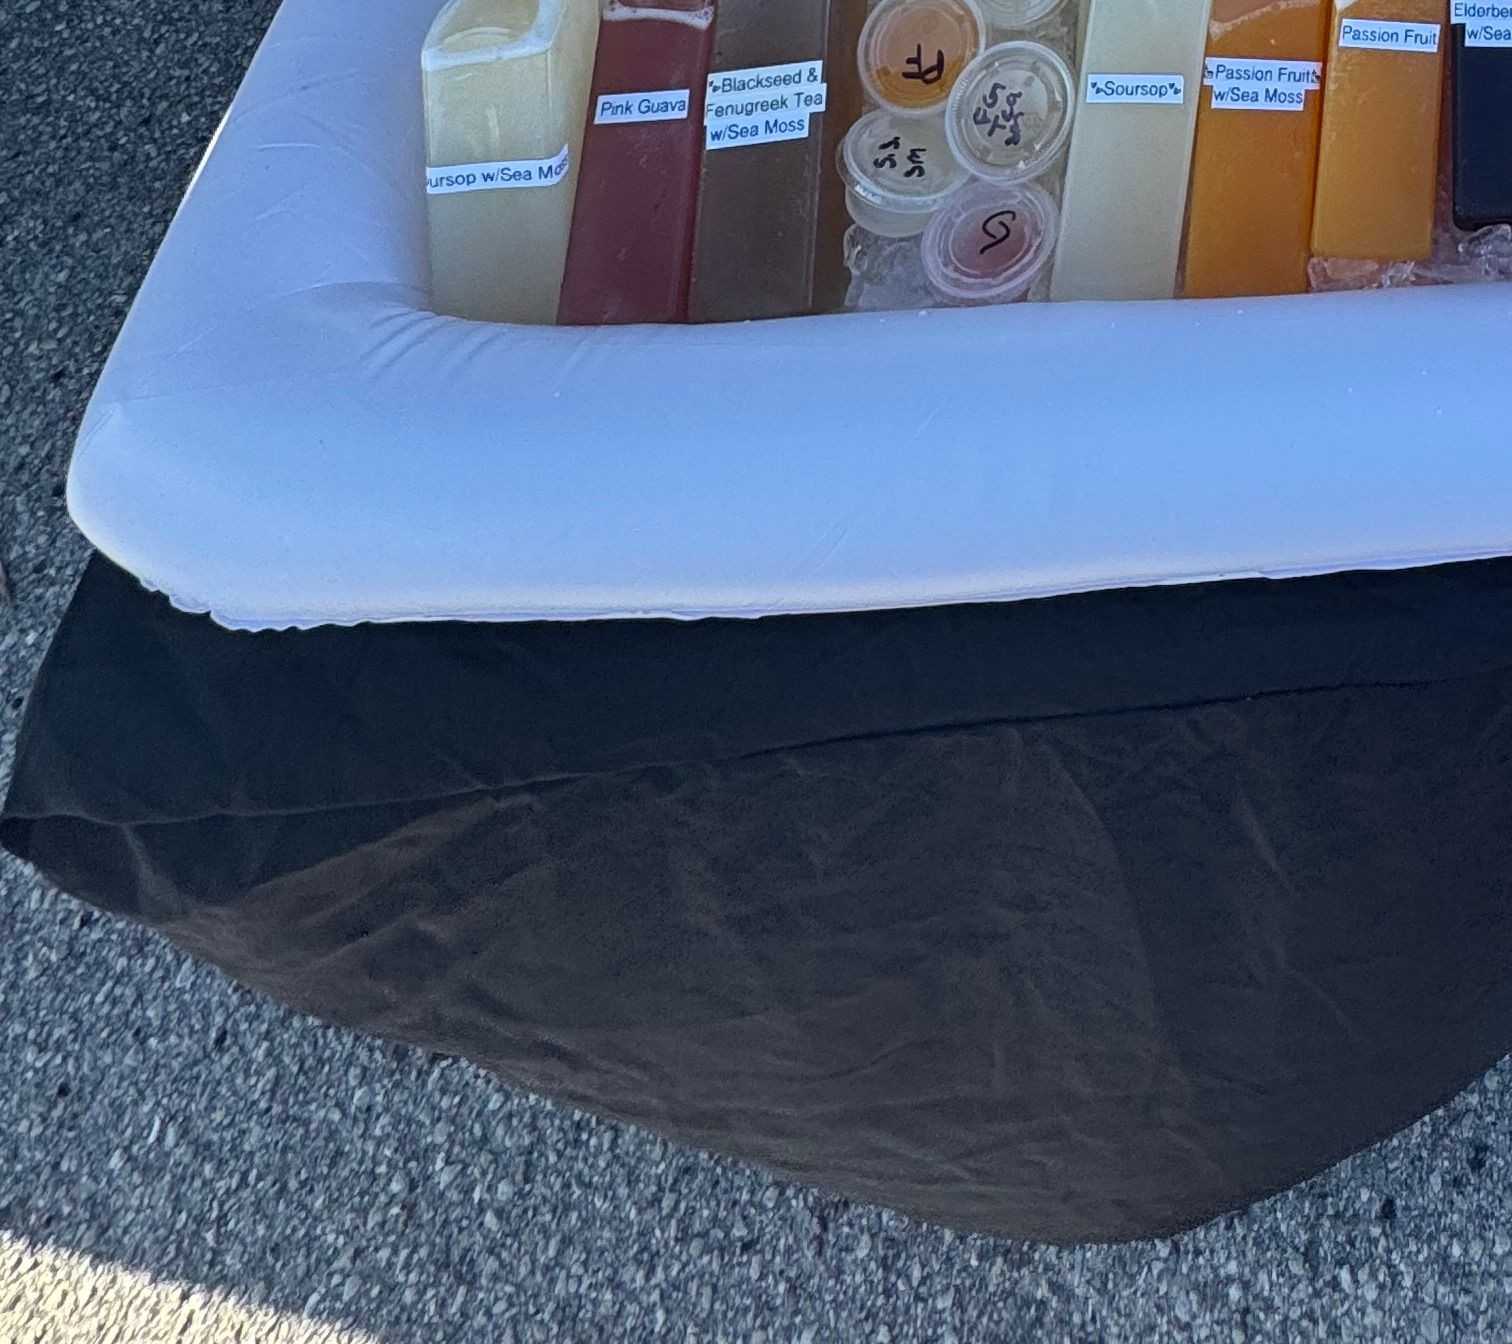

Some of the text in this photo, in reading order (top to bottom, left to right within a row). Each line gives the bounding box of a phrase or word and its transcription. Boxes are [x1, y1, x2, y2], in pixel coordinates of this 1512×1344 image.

[1342, 25, 1437, 46] Passion Fruit
[1466, 25, 1512, 41] w/Sea
[721, 67, 819, 93] Blackseed &
[1215, 63, 1312, 84] Passion Fruit
[1103, 80, 1169, 99] Soursop
[1214, 86, 1303, 103] w/Sea Moss
[600, 98, 687, 116] Pink Guava
[706, 92, 823, 118] Fenugreek Tea
[710, 118, 805, 141] w/Sea Moss
[482, 167, 532, 183] w/Sea
